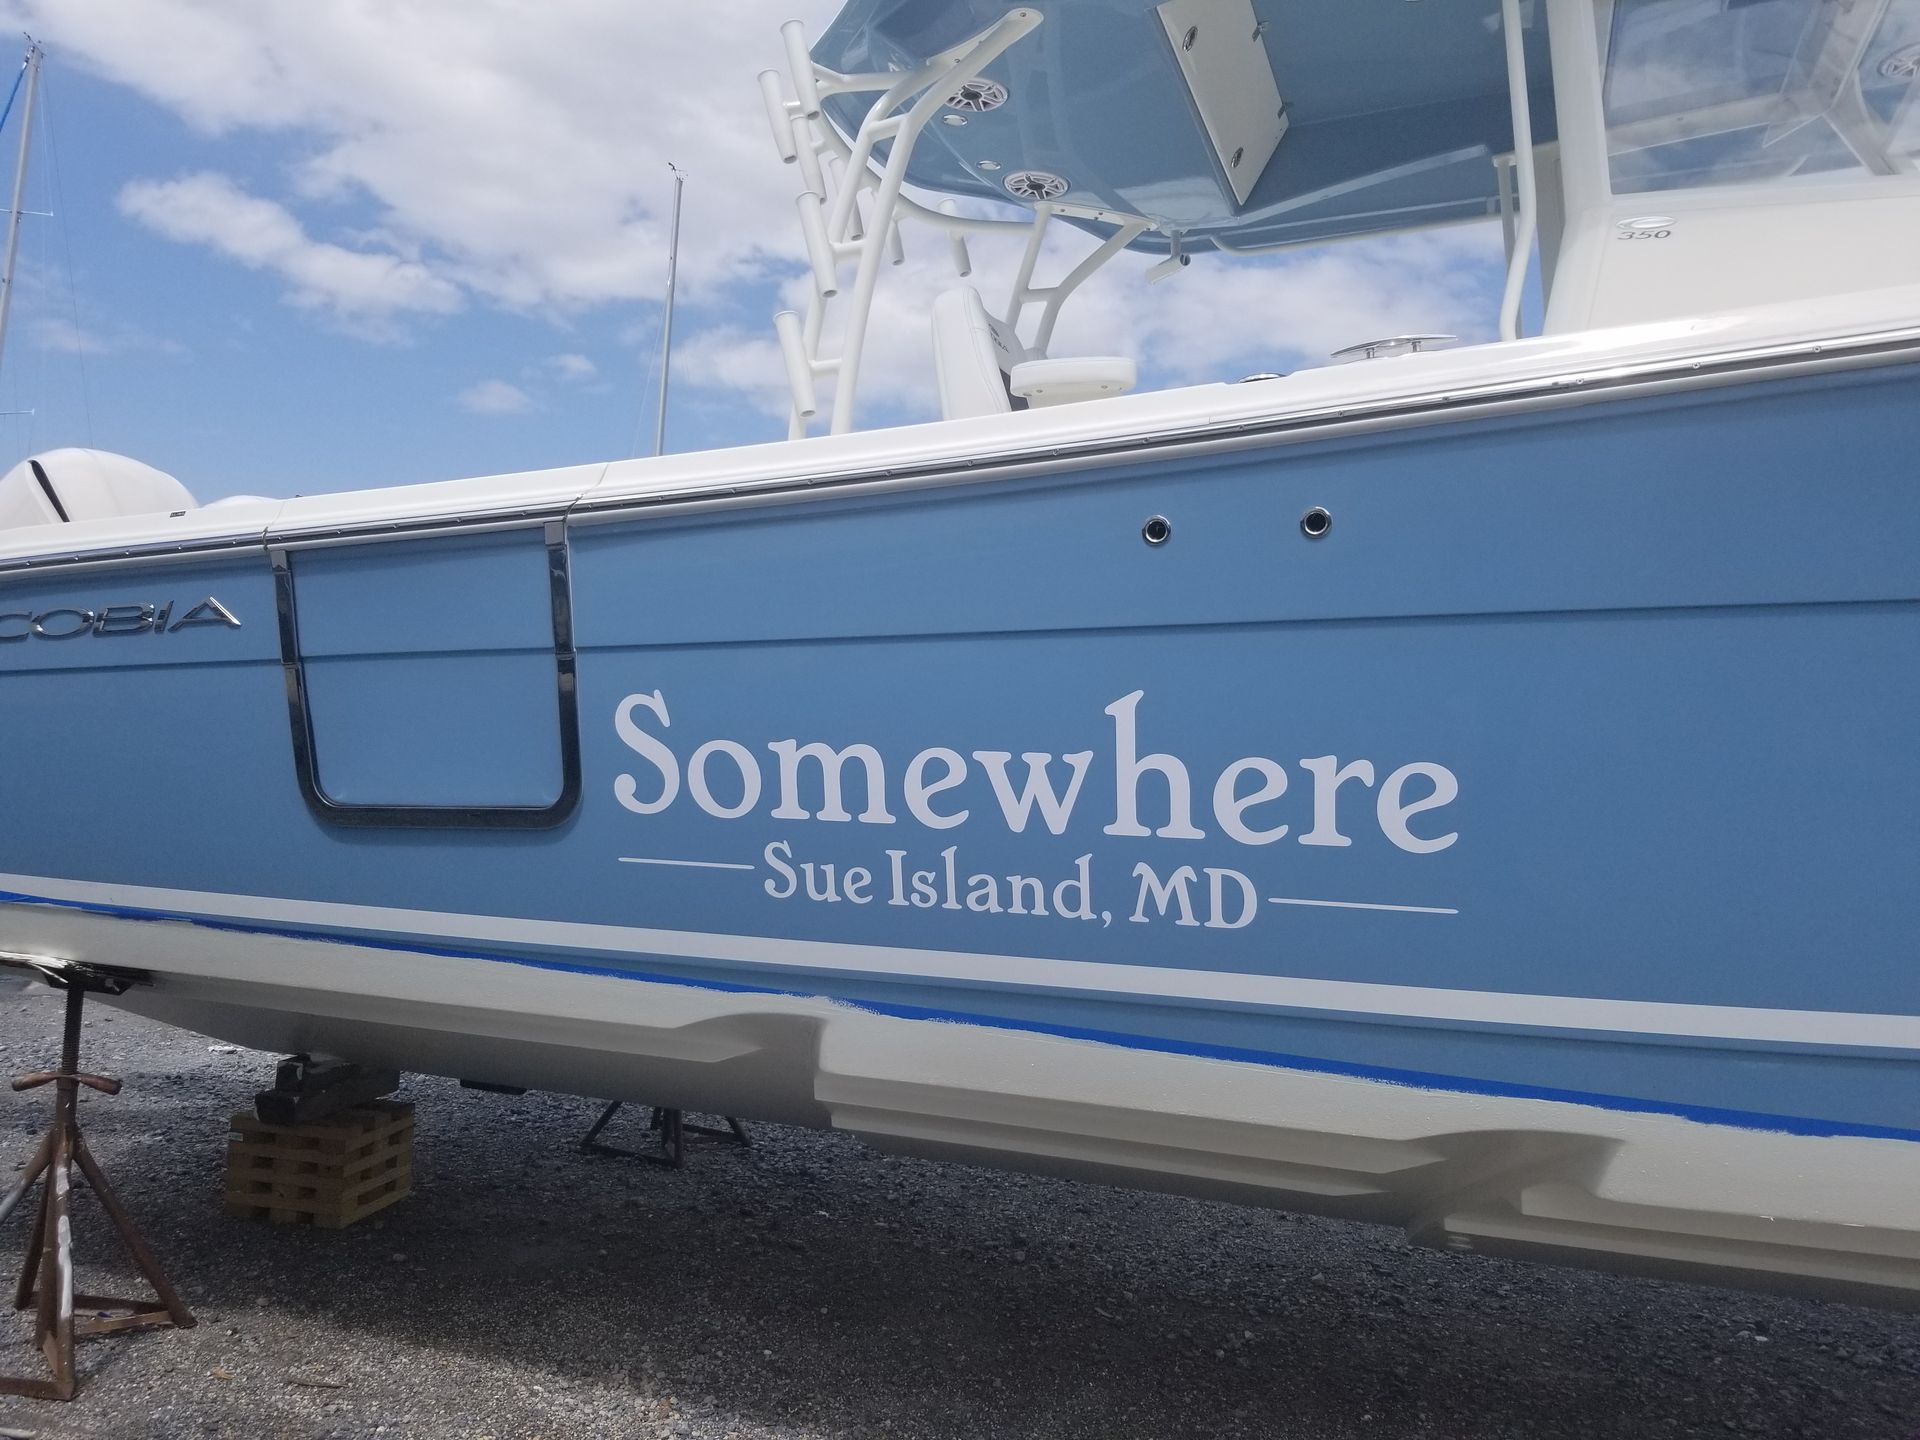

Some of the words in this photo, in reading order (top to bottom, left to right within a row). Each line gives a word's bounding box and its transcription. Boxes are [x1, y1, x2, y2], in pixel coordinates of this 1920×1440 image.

[1617, 229, 1672, 241] 350
[613, 688, 1460, 855] Somewhere
[763, 840, 874, 905] Sue
[885, 844, 1113, 929] Island,
[1128, 861, 1259, 930] MD
